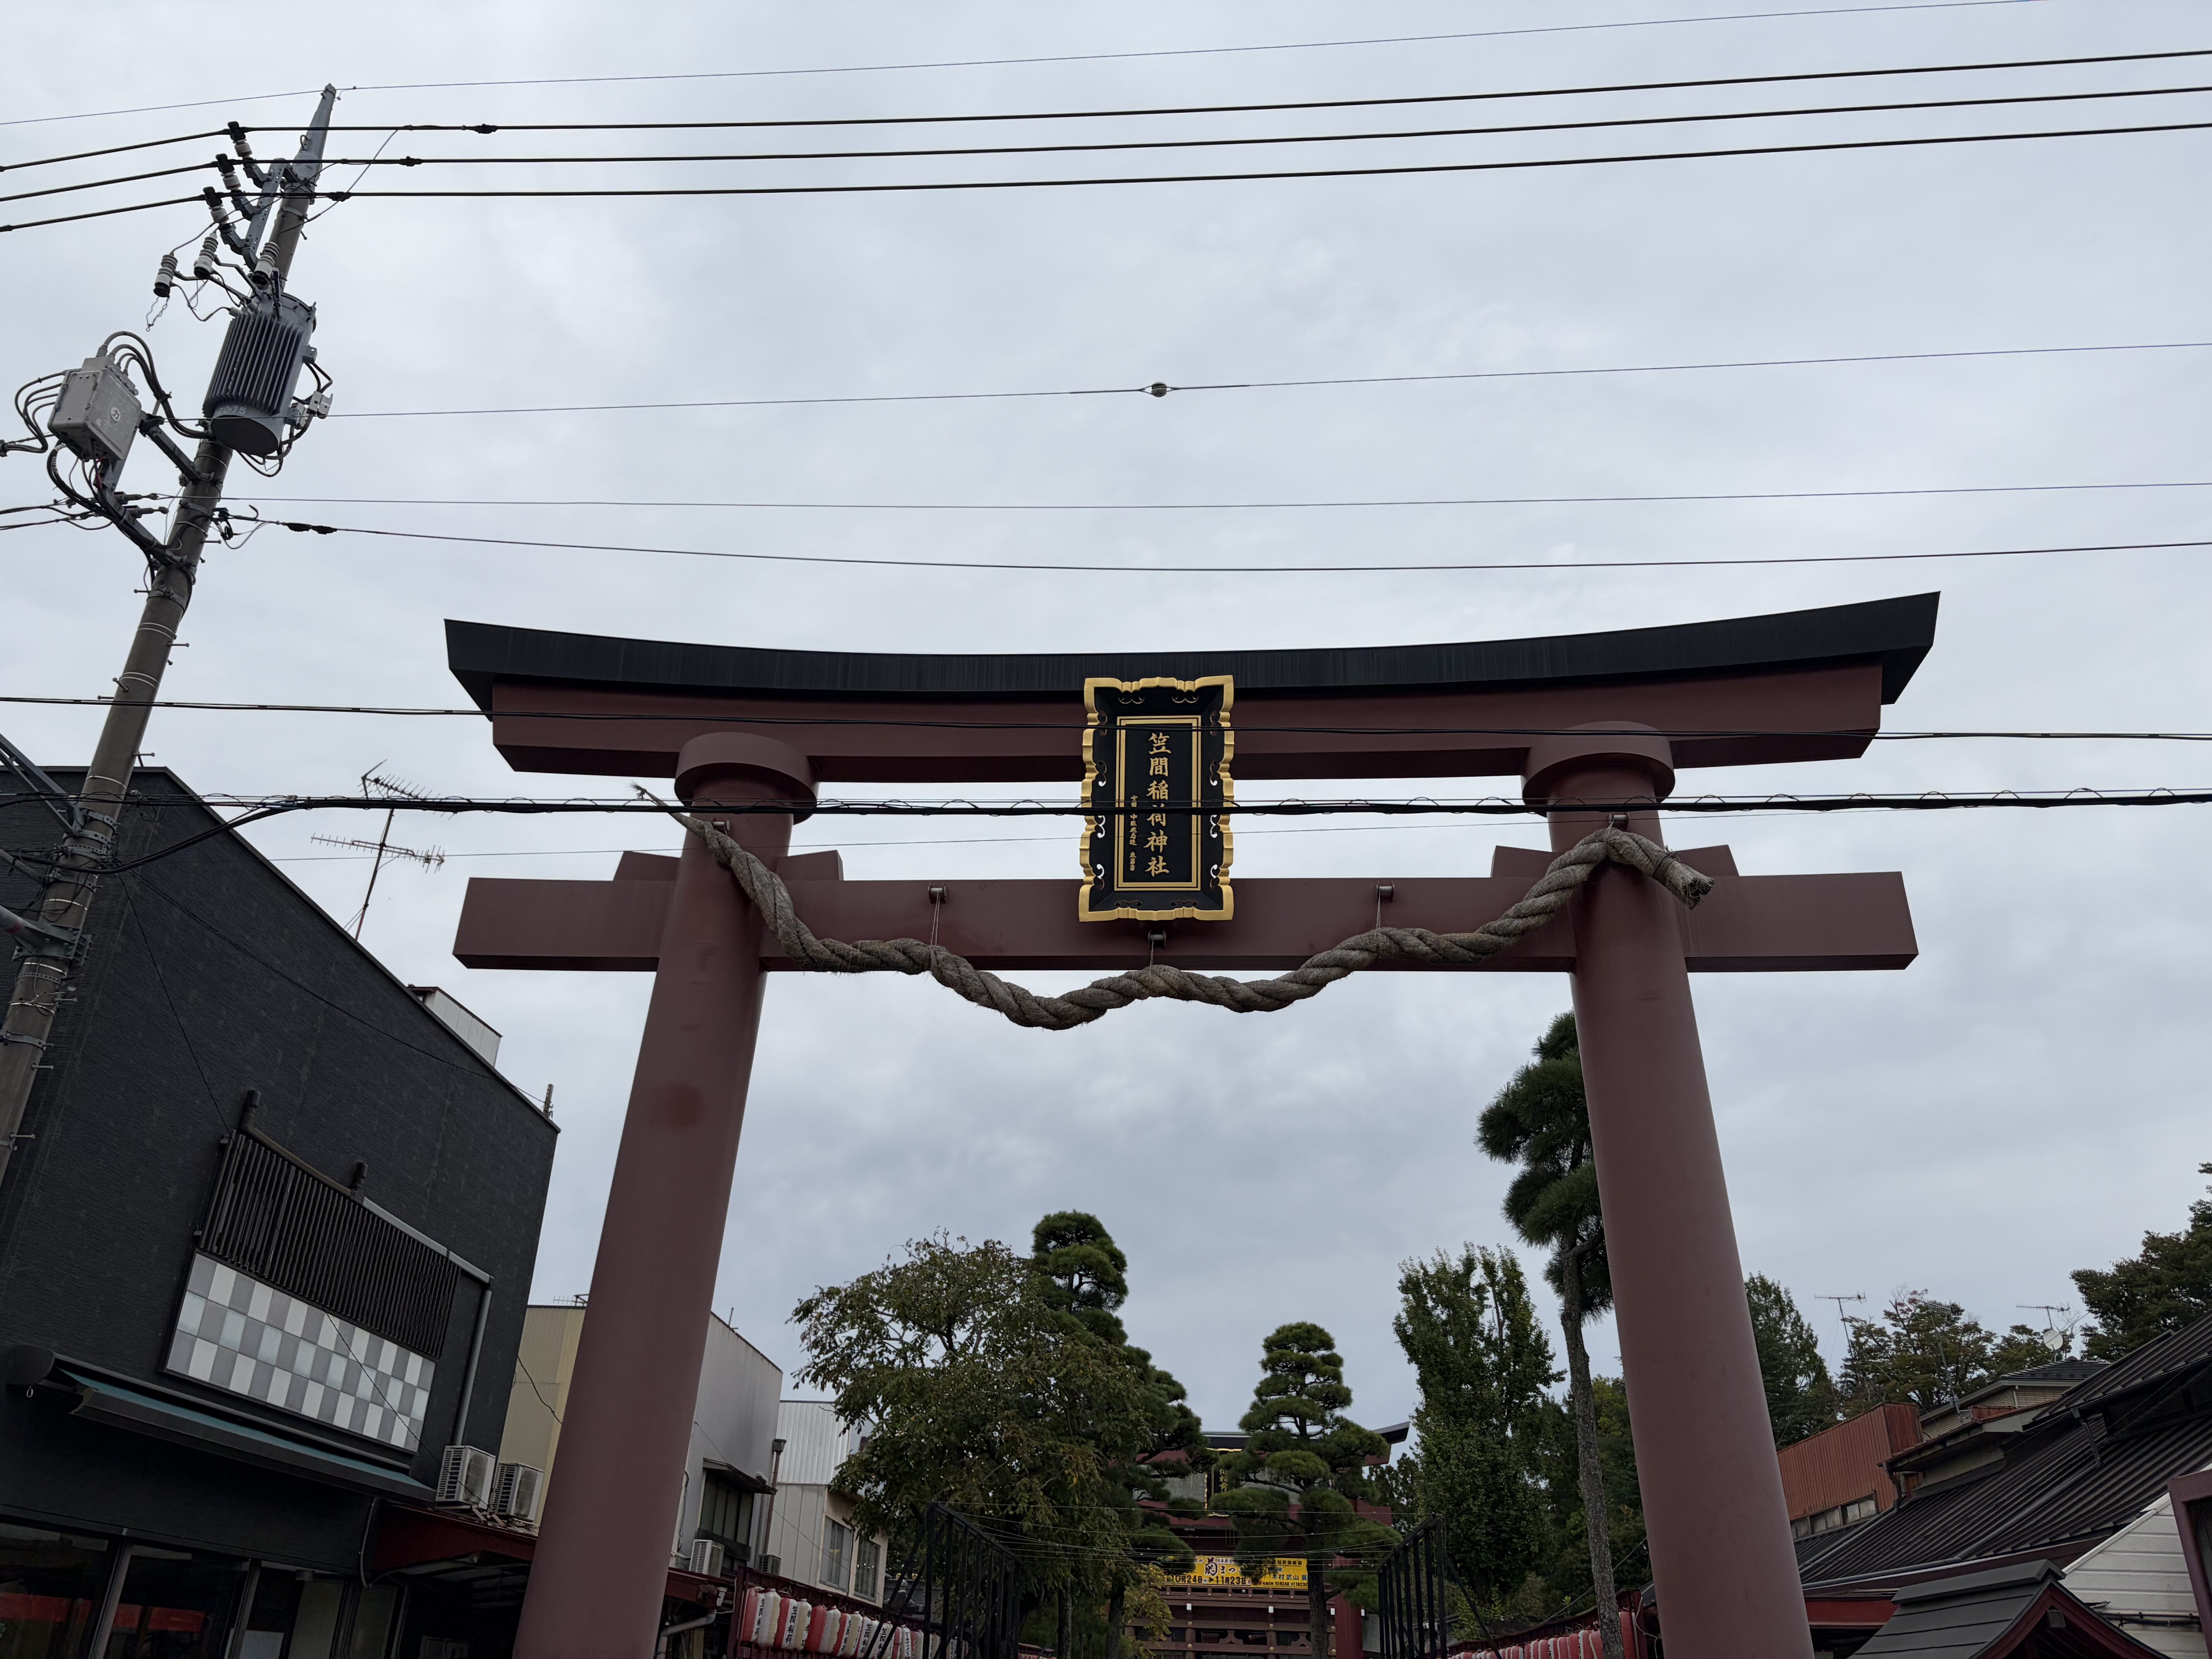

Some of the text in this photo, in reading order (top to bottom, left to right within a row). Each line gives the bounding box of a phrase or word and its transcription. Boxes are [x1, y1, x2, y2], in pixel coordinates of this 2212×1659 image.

[1144, 732, 1172, 878] 笠間稲荷神社
